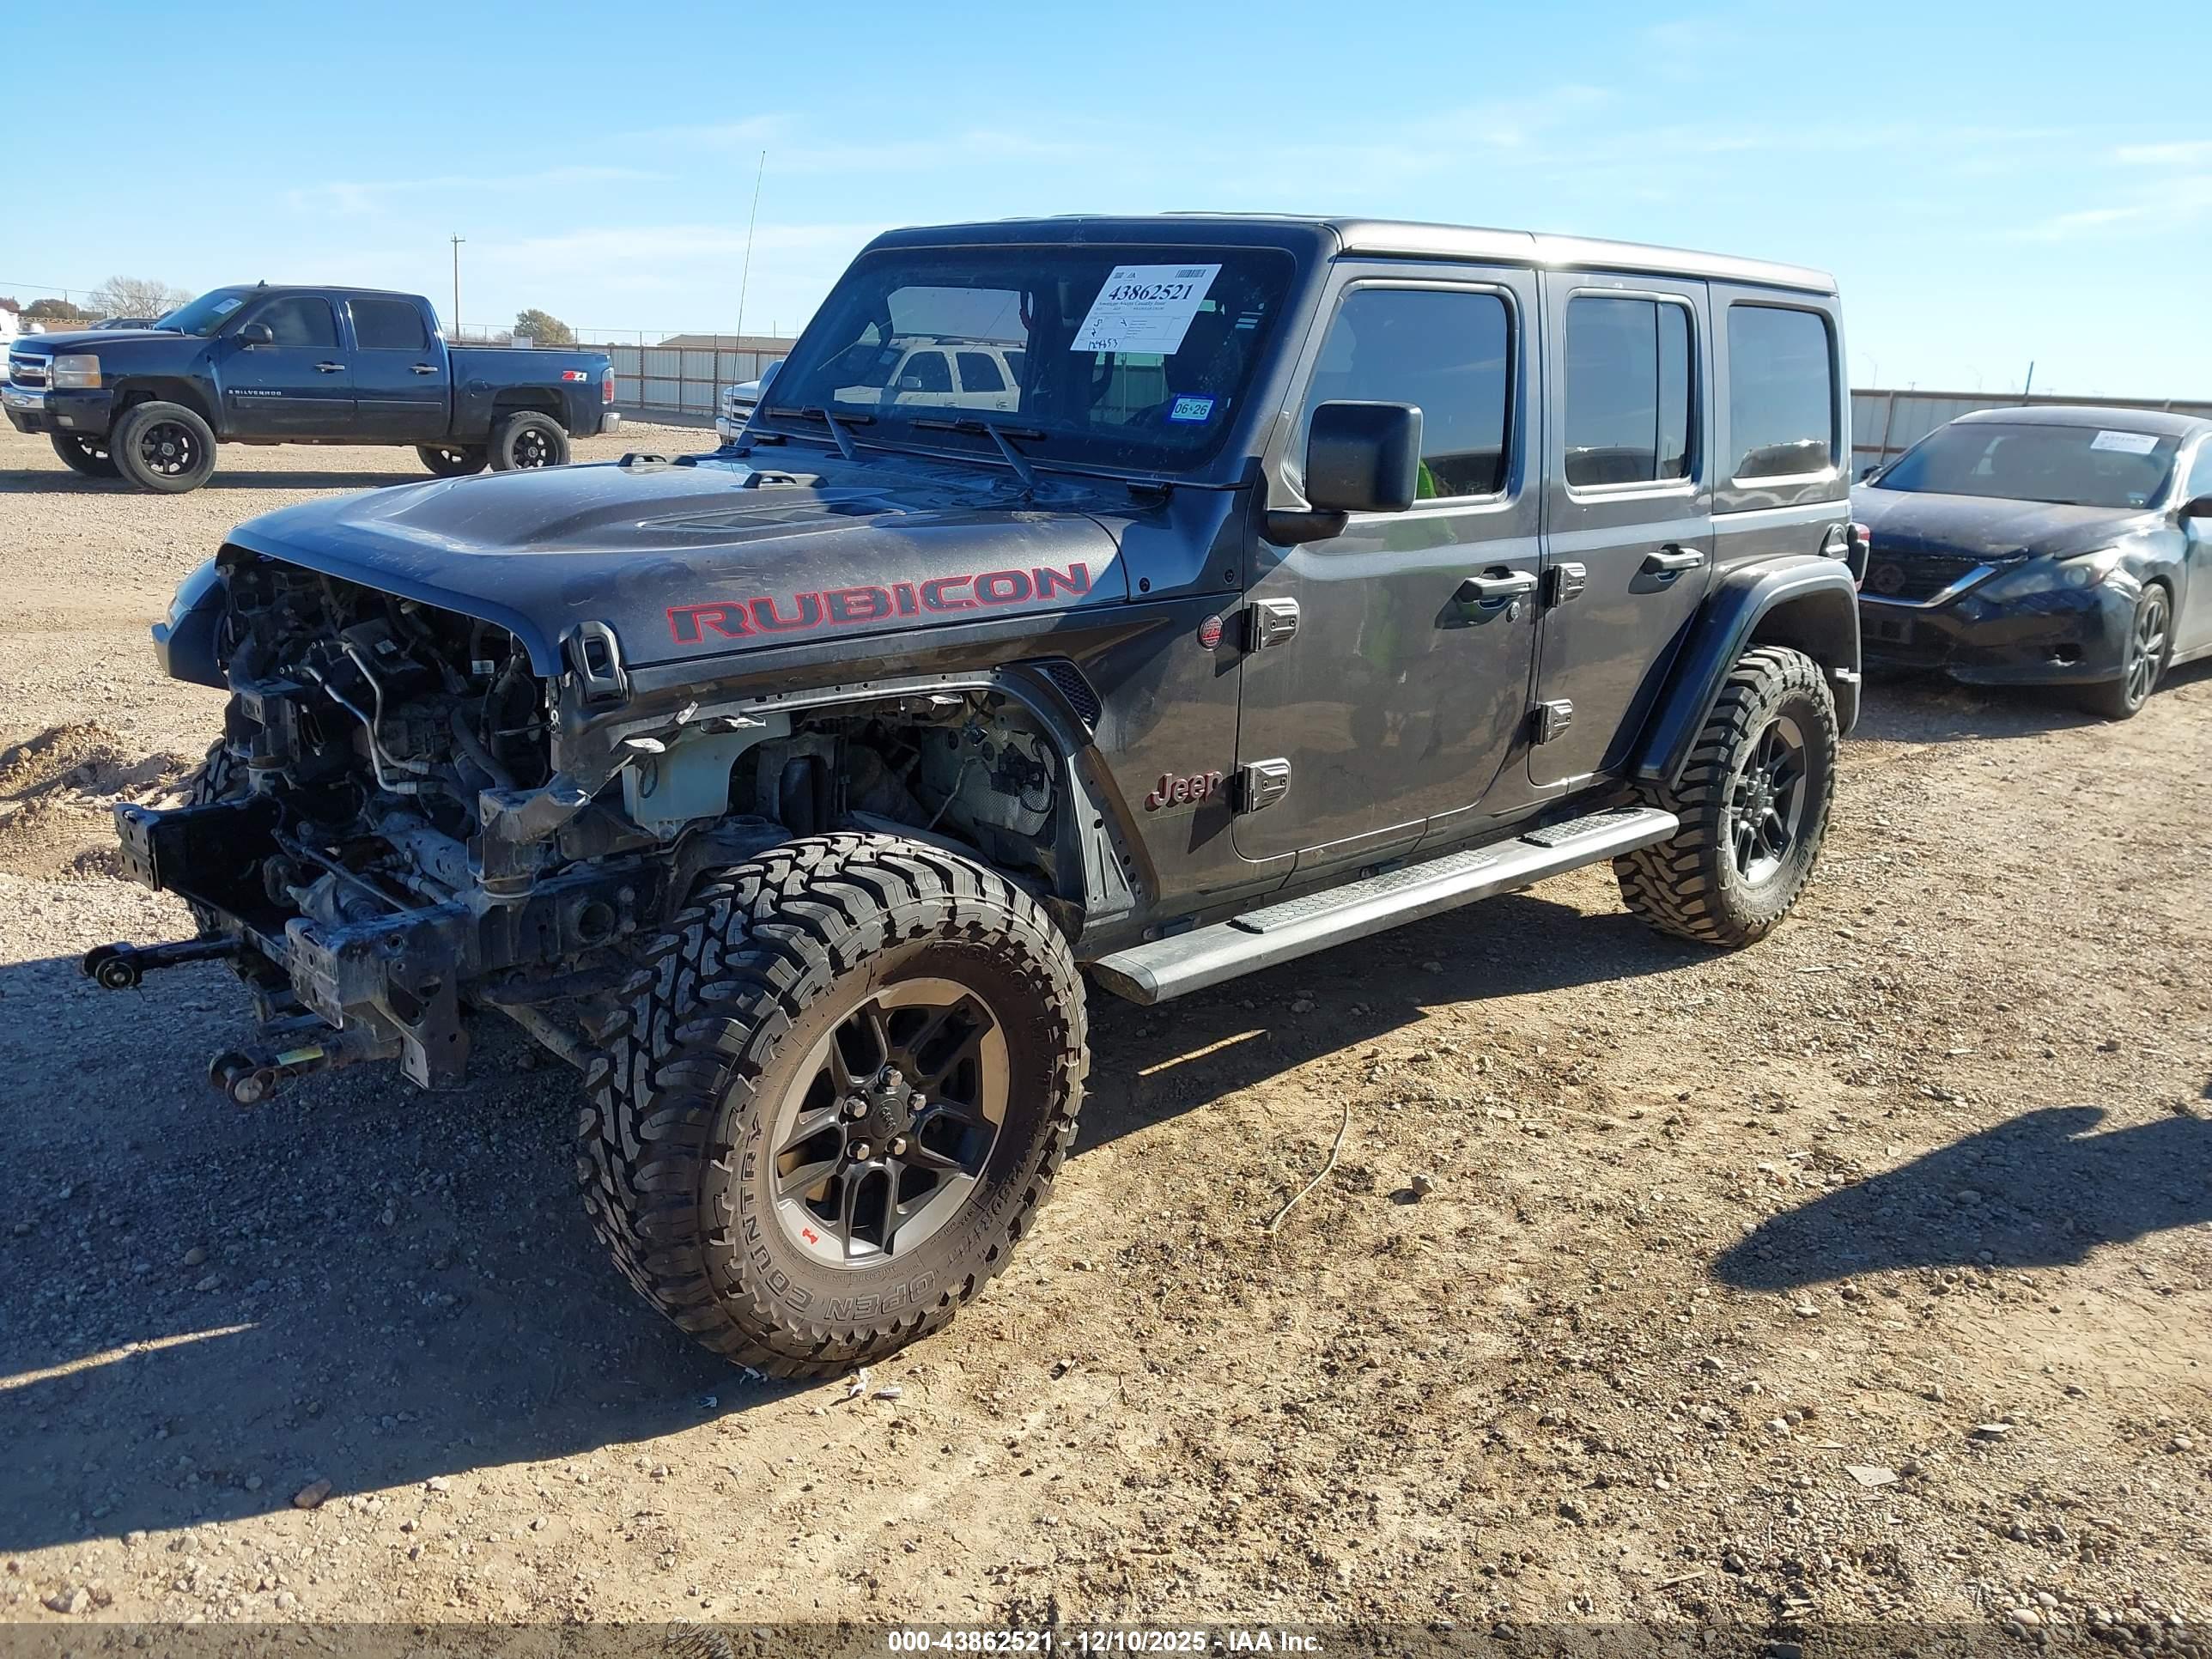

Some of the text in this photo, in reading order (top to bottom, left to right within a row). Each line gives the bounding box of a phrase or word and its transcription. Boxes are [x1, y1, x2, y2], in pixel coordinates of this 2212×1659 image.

[1109, 284, 1194, 300] 43862521
[562, 371, 587, 381] Z71
[666, 563, 1091, 645] RUBICON
[1146, 771, 1224, 807] Jeep
[740, 1110, 935, 1322] OPEN COUNTRY
